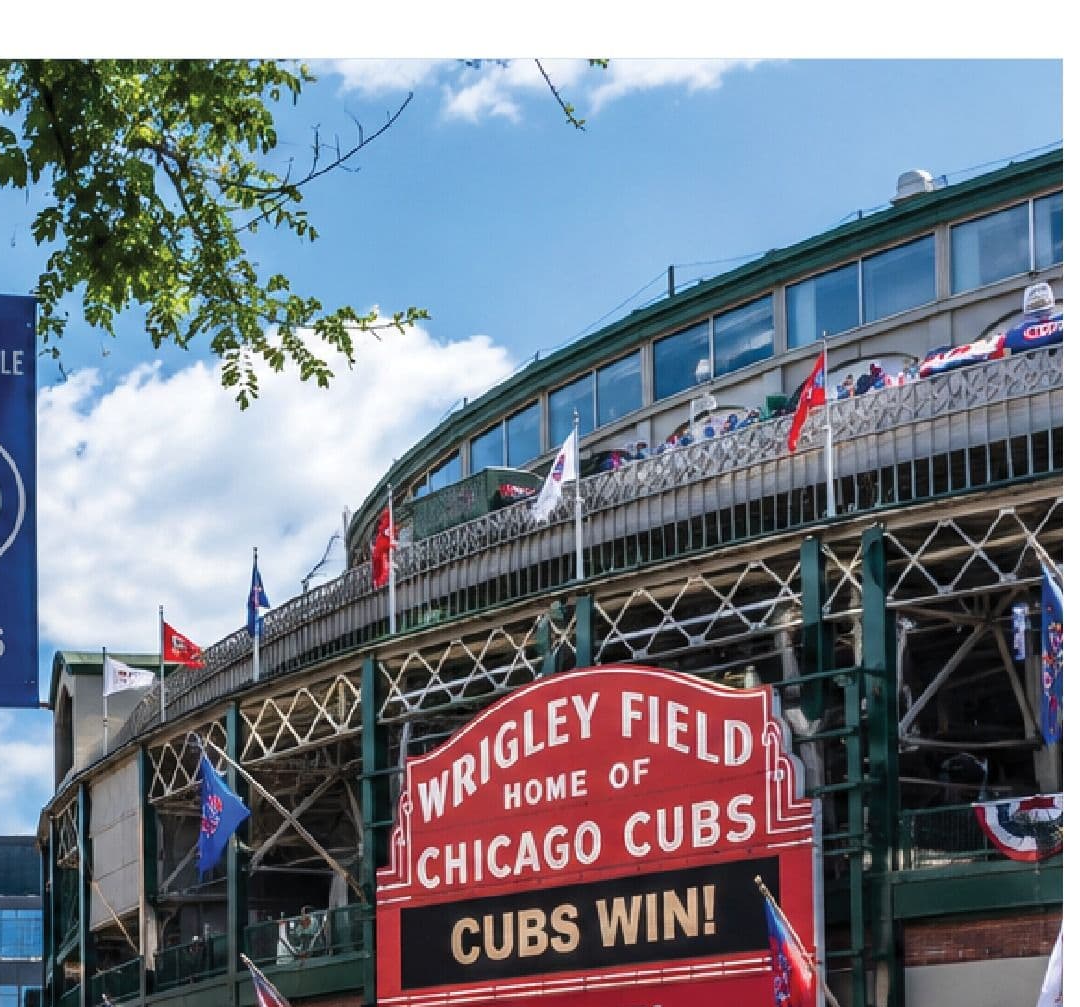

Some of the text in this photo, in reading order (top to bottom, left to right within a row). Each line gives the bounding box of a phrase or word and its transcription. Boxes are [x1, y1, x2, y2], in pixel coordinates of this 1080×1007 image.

[417, 691, 753, 824] WRIGLEY FIELD
[504, 757, 651, 810] HOME OF
[416, 793, 756, 889] CHICAGO CUBS
[450, 884, 717, 966] CUBS WIN!
